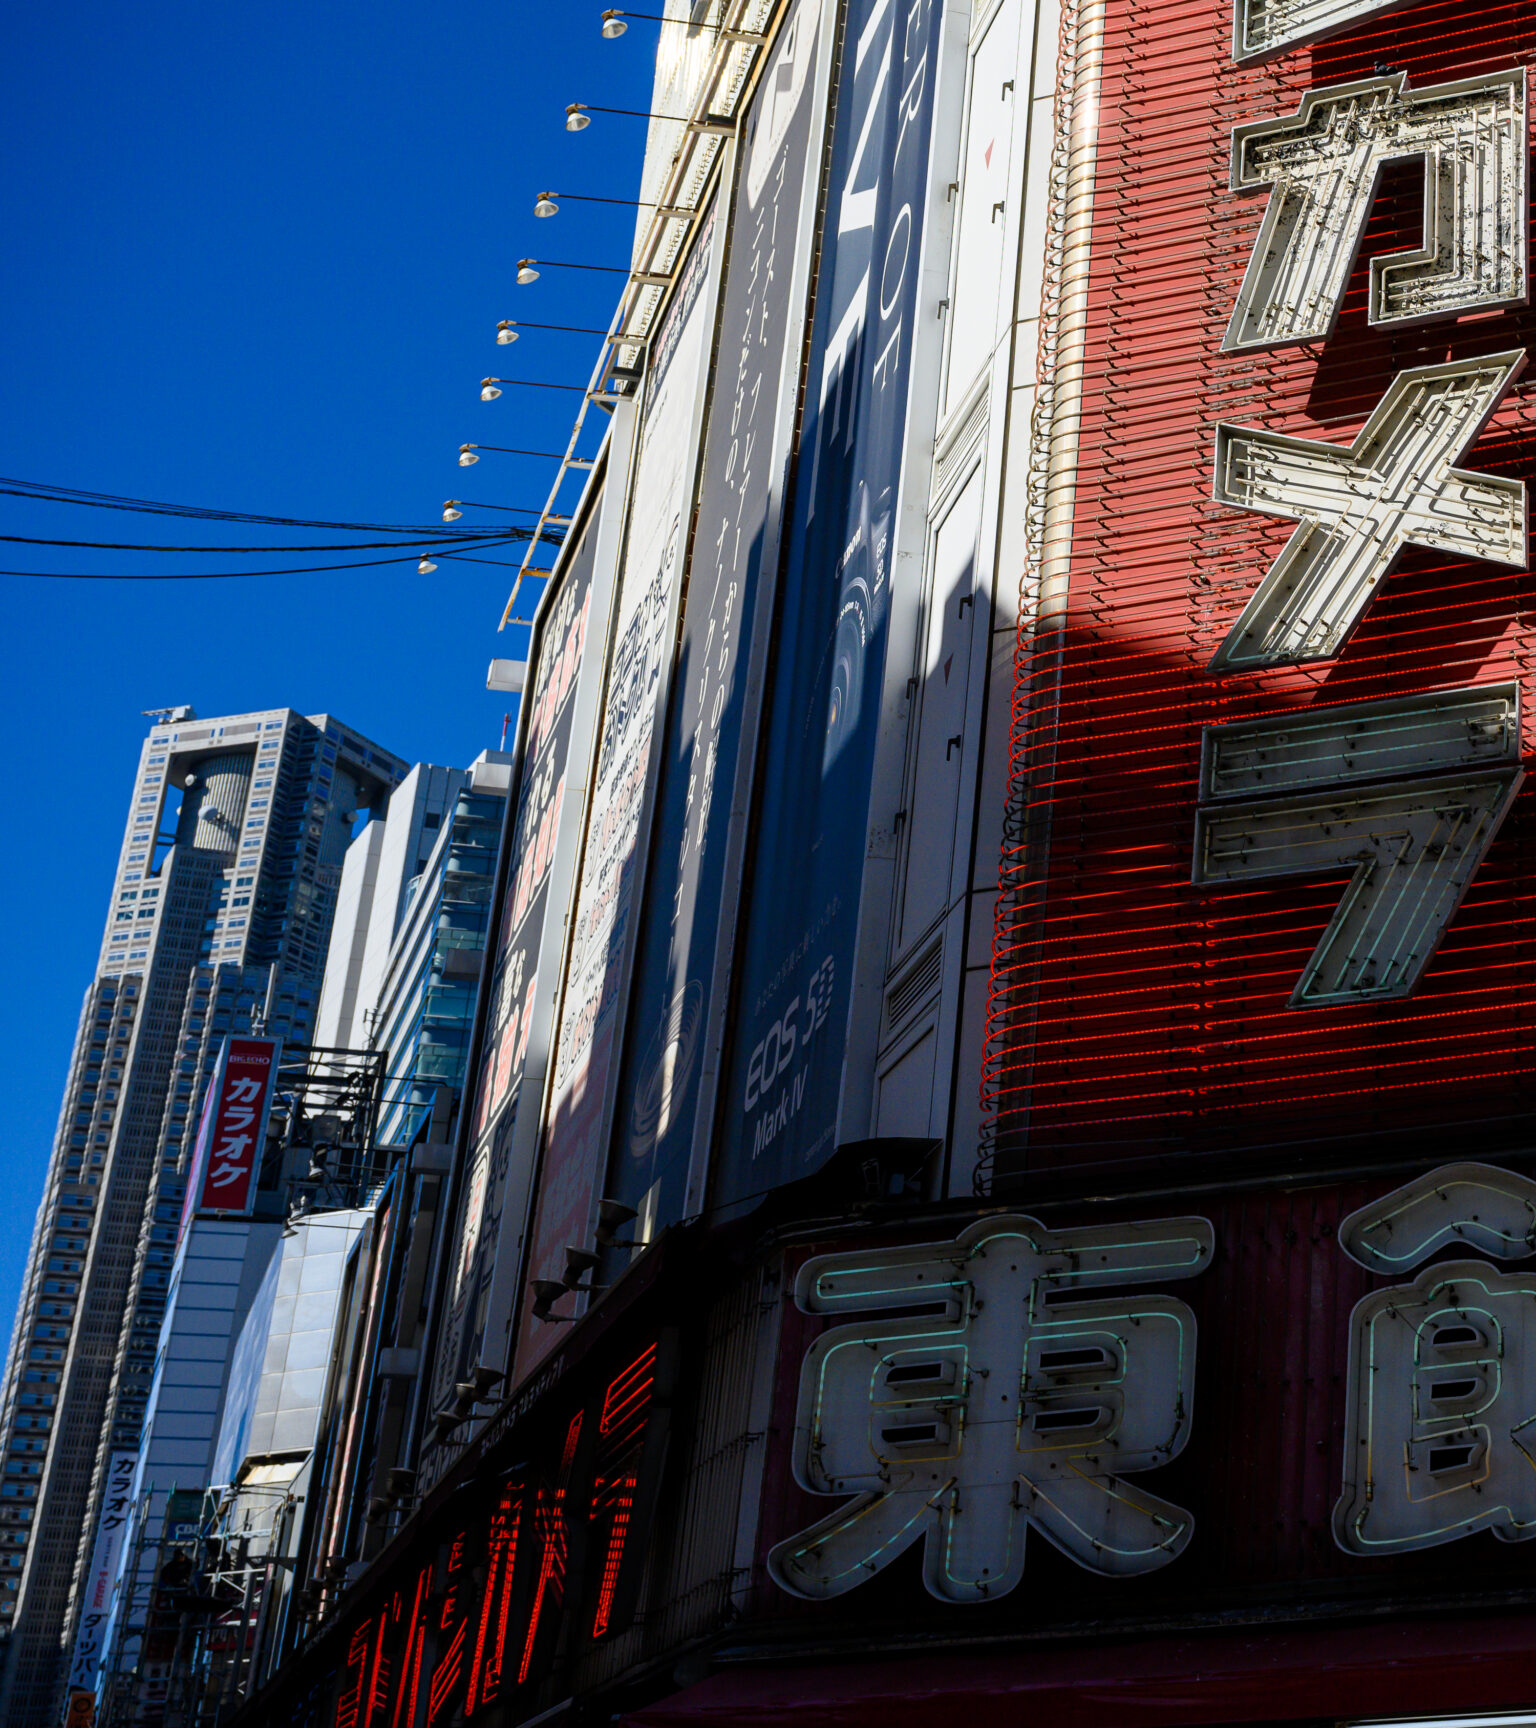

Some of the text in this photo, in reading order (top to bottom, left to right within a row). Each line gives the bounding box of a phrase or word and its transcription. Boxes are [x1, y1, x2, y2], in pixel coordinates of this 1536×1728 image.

[1190, 0, 1530, 1010] カメラ
[744, 995, 800, 1113] EOS
[801, 953, 835, 1047] 5D
[209, 1076, 263, 1189] カラオケ
[752, 1063, 809, 1161] Mark IV
[103, 1457, 137, 1531] カラオケ
